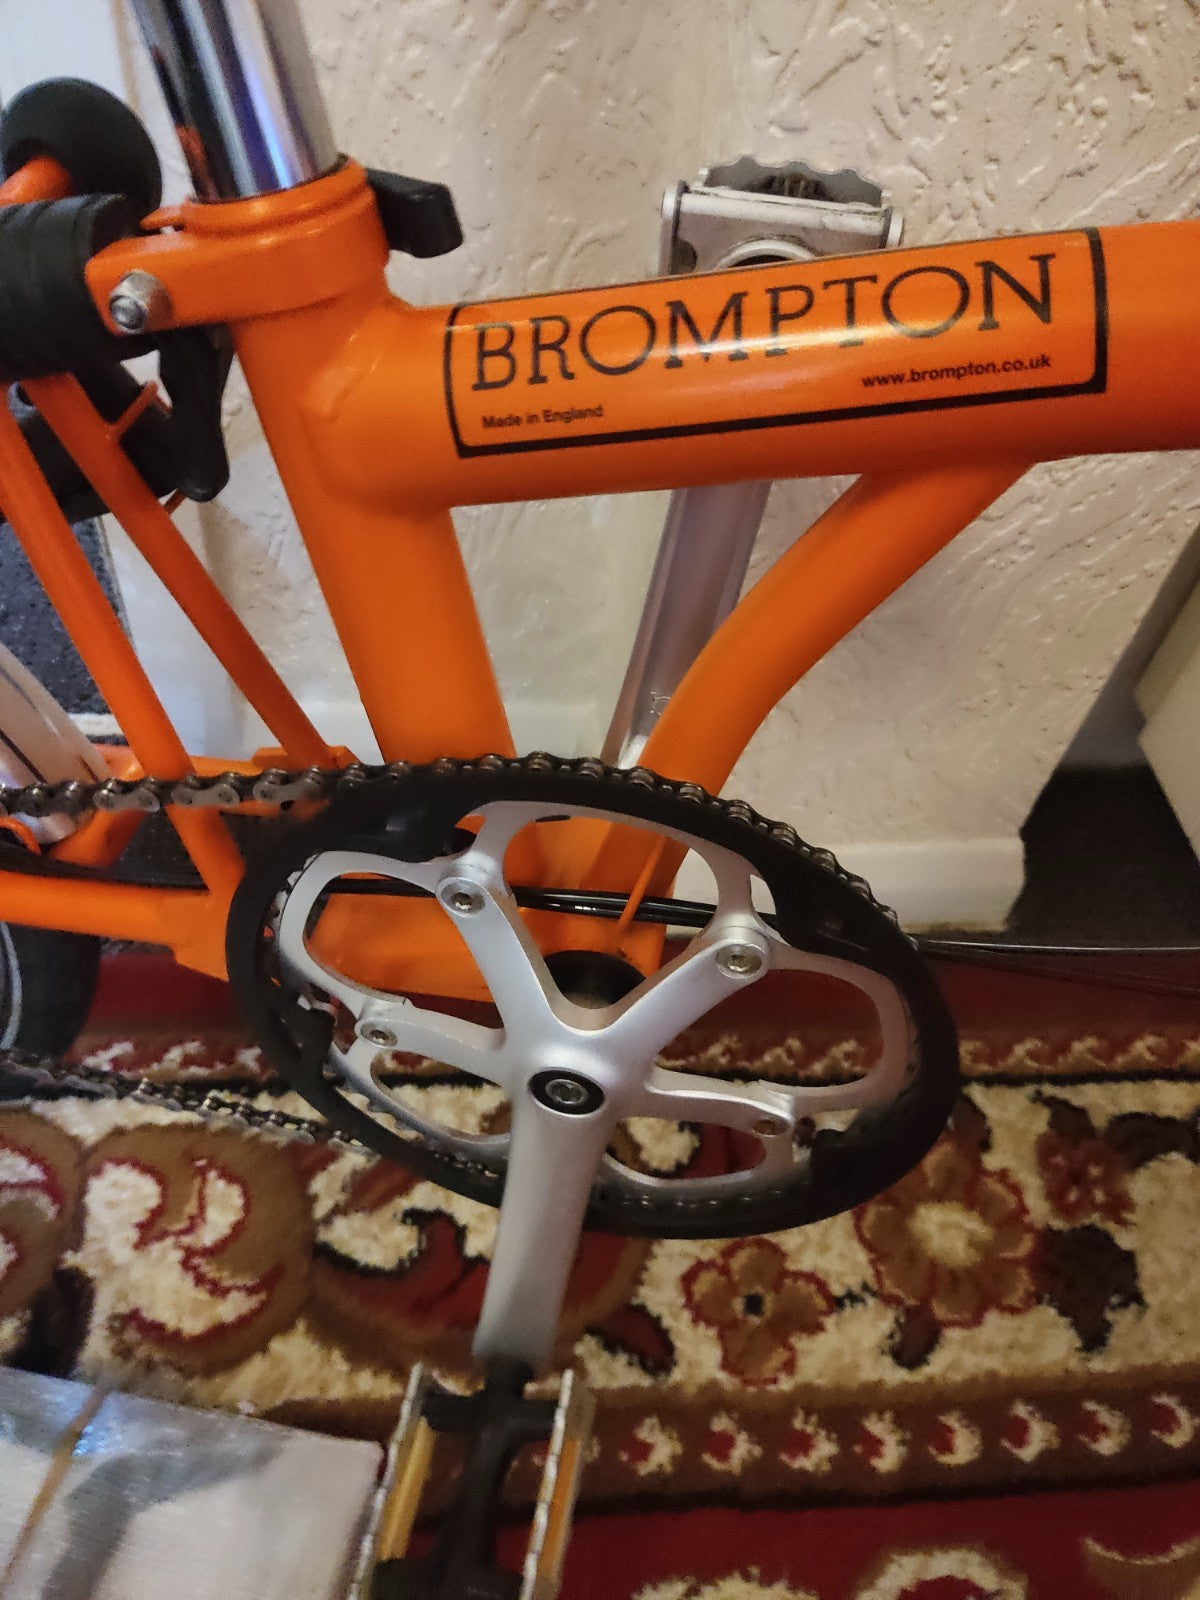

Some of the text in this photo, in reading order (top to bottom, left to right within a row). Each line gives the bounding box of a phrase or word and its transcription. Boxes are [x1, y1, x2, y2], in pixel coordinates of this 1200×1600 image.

[471, 253, 1056, 391] BROMPTON
[861, 353, 1051, 387] www.brompton.co.uk
[481, 405, 603, 428] Made in England
